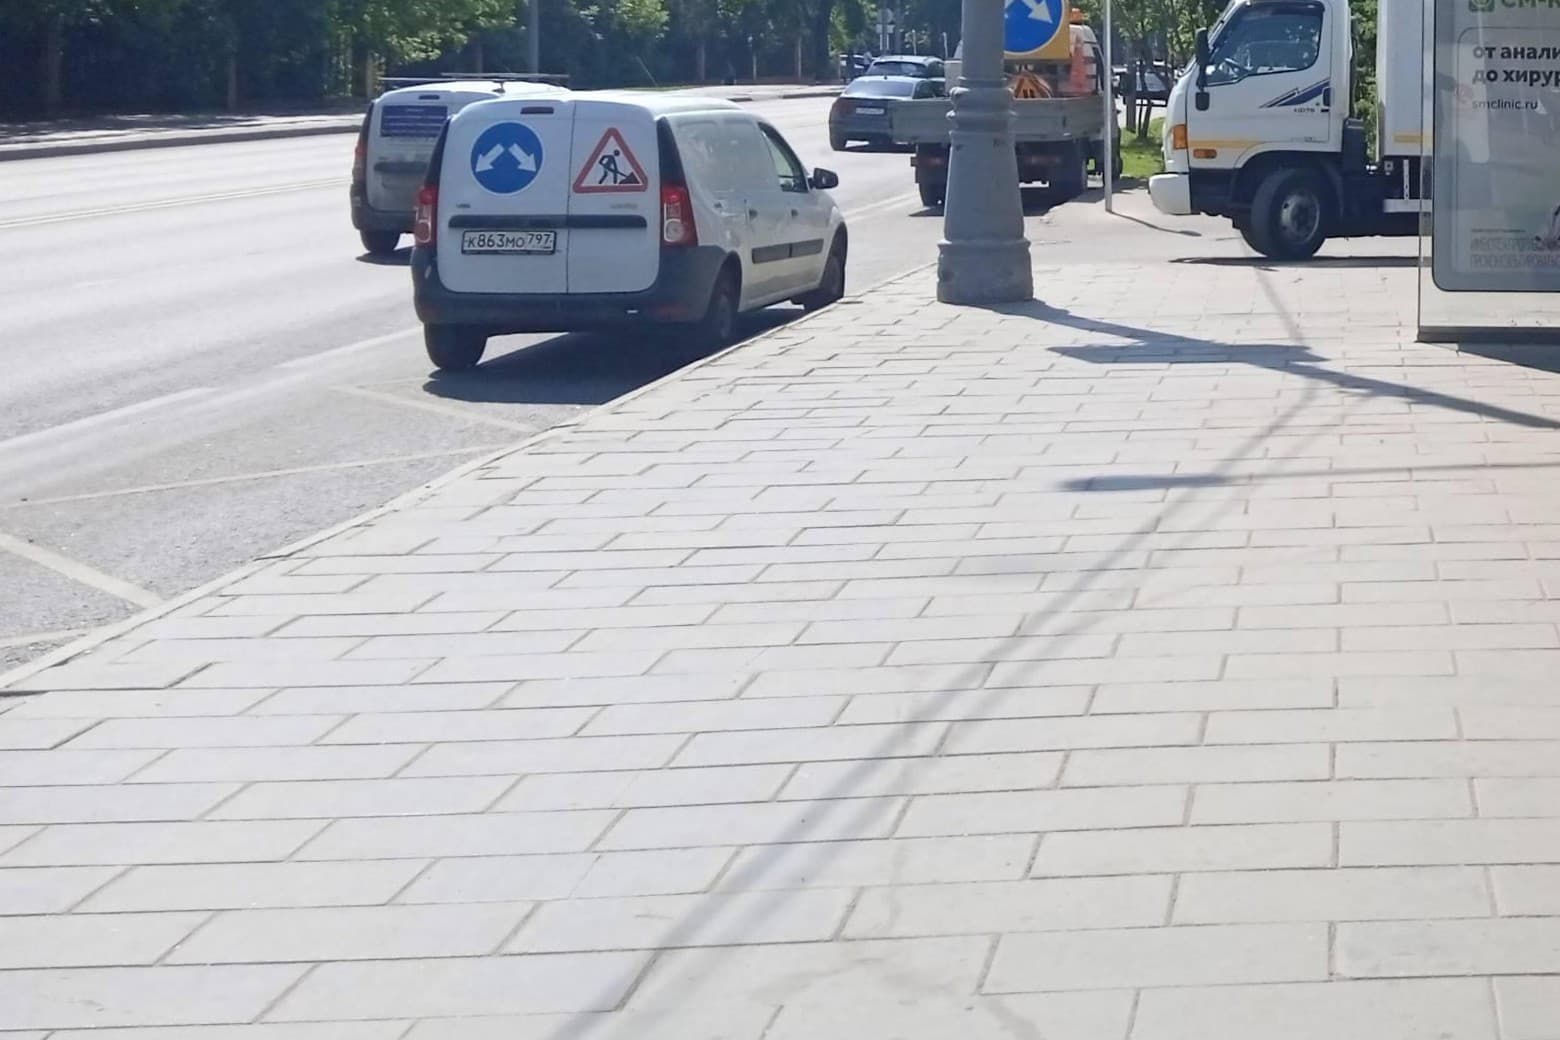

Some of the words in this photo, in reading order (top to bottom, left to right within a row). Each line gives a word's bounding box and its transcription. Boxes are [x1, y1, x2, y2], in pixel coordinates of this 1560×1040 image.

[1473, 46, 1496, 60] от
[1472, 69, 1498, 86] до
[1472, 98, 1538, 110] smclinic.ru
